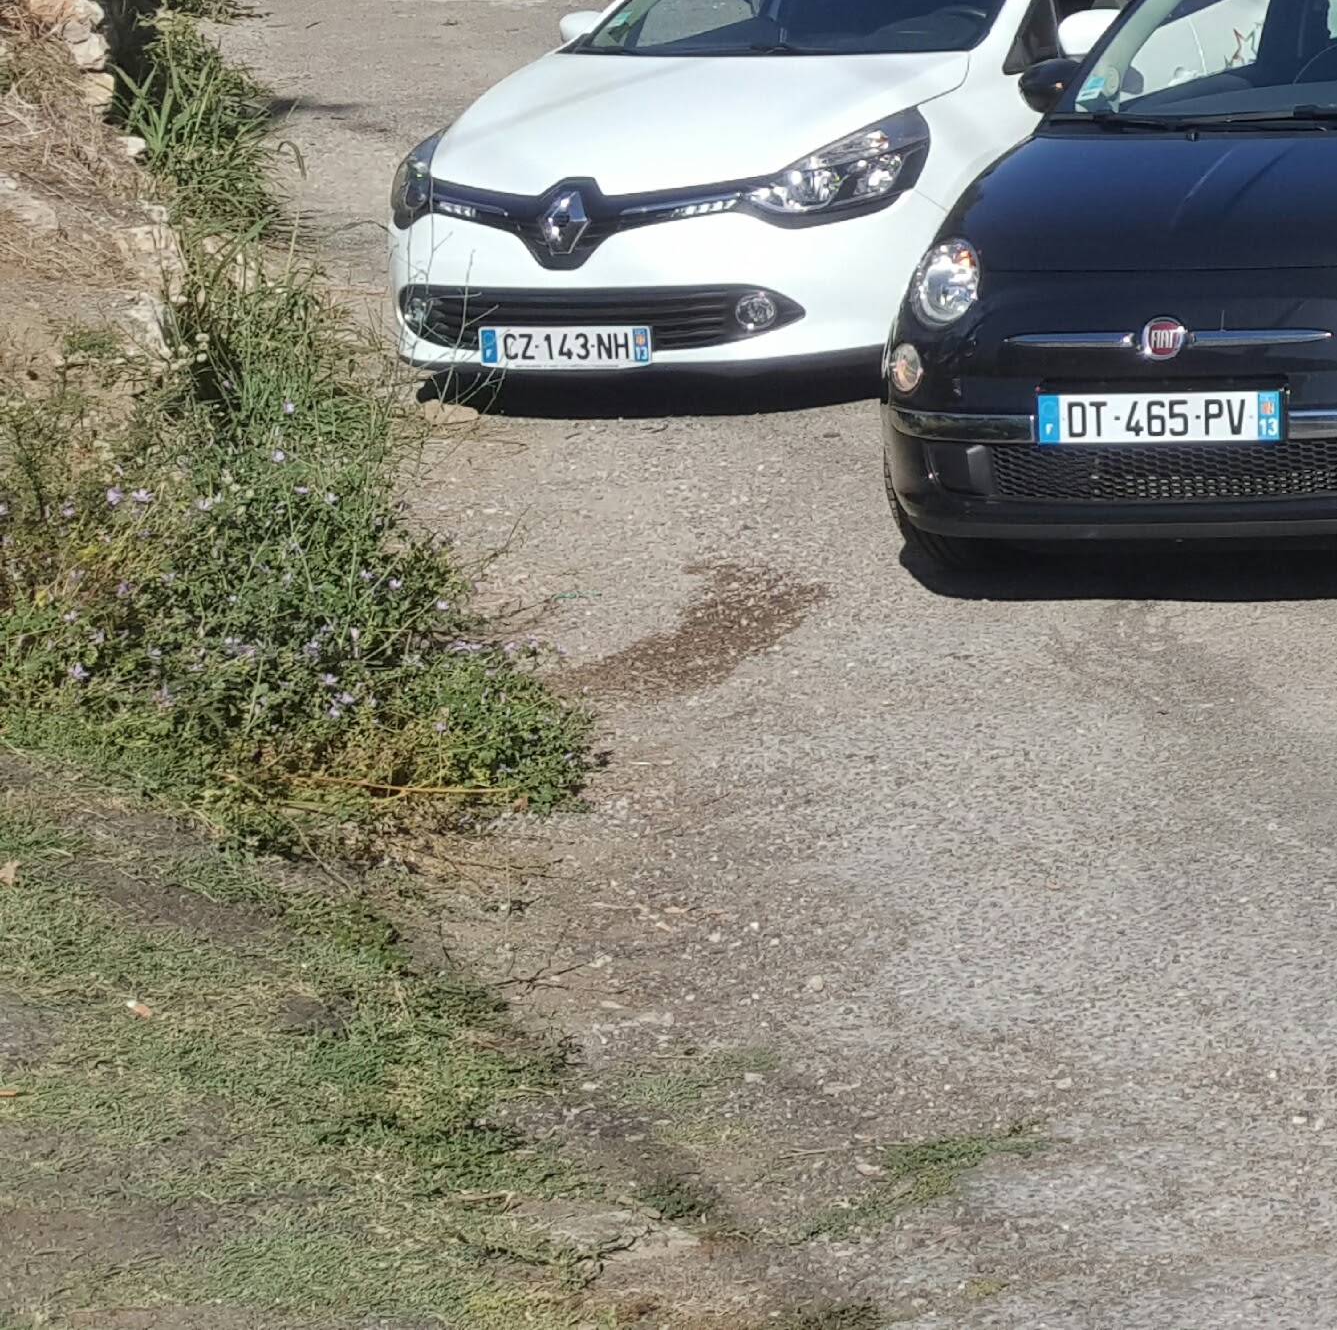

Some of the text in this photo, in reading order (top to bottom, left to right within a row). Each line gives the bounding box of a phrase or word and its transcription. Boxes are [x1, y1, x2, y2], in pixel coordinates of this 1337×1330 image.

[503, 331, 630, 361] CZ-143-NH
[634, 346, 649, 361] 13
[1150, 328, 1176, 349] FIAT
[1066, 398, 1246, 438] DT-465-PV
[1259, 417, 1279, 437] 13
